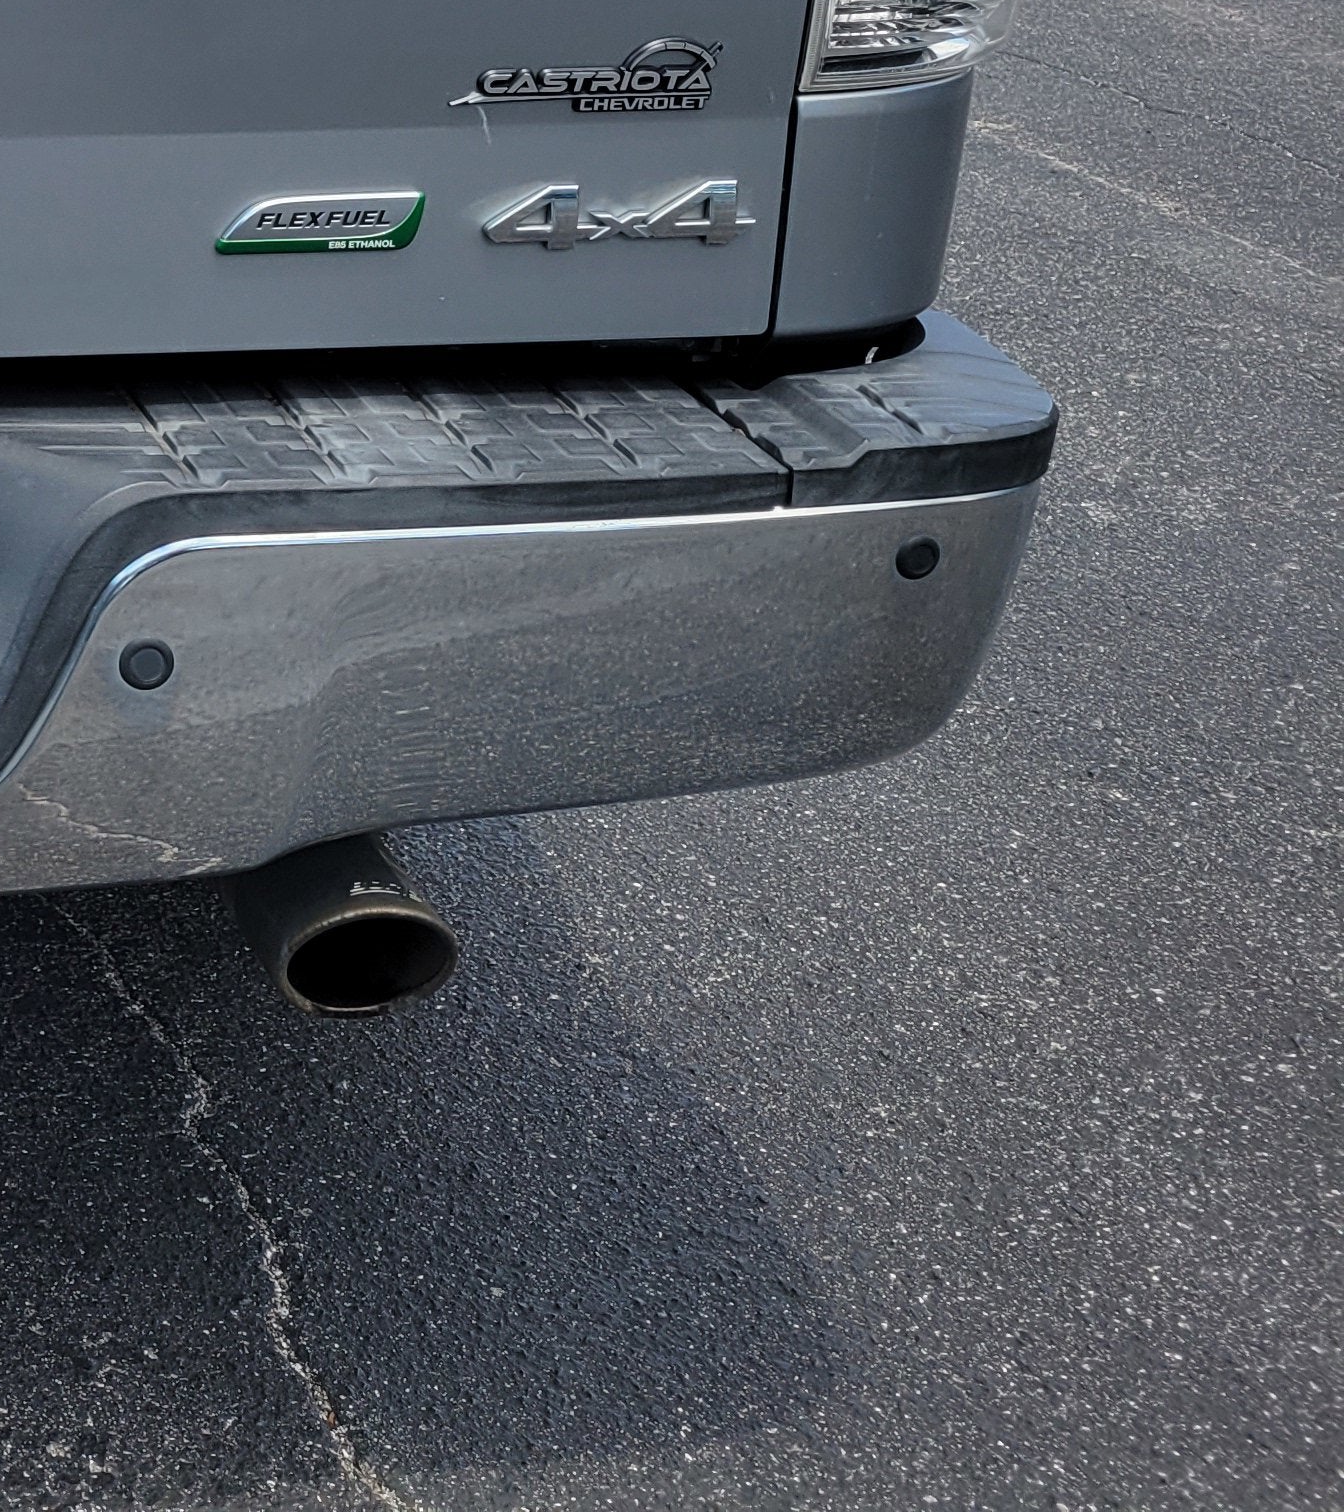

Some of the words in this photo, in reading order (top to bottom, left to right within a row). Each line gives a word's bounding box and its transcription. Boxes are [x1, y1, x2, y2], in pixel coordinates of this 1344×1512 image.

[481, 68, 712, 95] CASTRIOTA
[579, 96, 708, 112] CHEVROLET
[482, 180, 756, 251] 4x4
[328, 241, 346, 249] E85
[348, 239, 395, 249] ETHANOL
